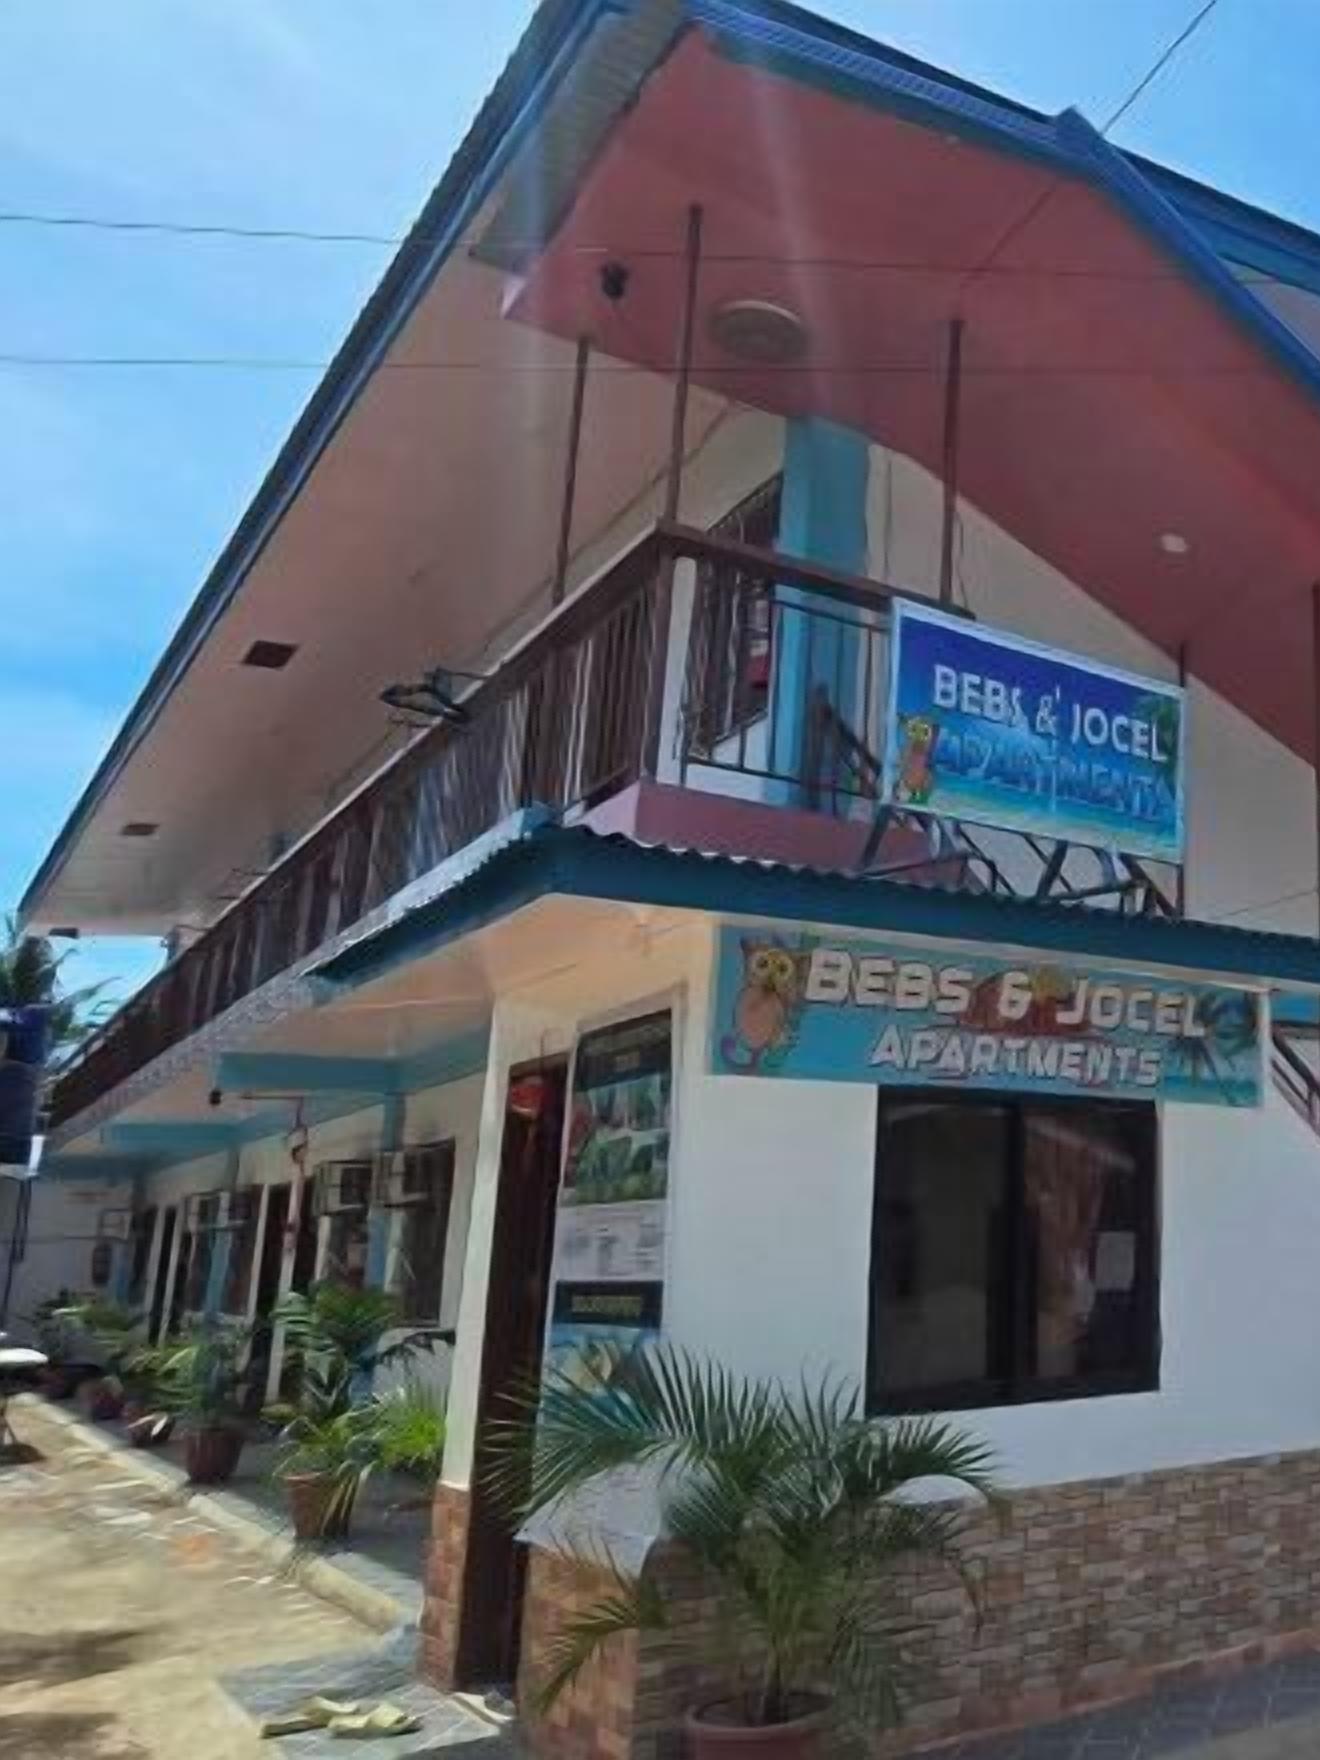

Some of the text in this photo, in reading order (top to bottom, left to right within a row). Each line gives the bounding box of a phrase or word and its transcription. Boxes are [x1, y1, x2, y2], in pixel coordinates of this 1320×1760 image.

[1071, 703, 1167, 762] JOCEL
[804, 948, 974, 1015] BEBS
[1055, 976, 1206, 1037] JOCEL
[869, 1023, 1161, 1086] APARTMENTS
